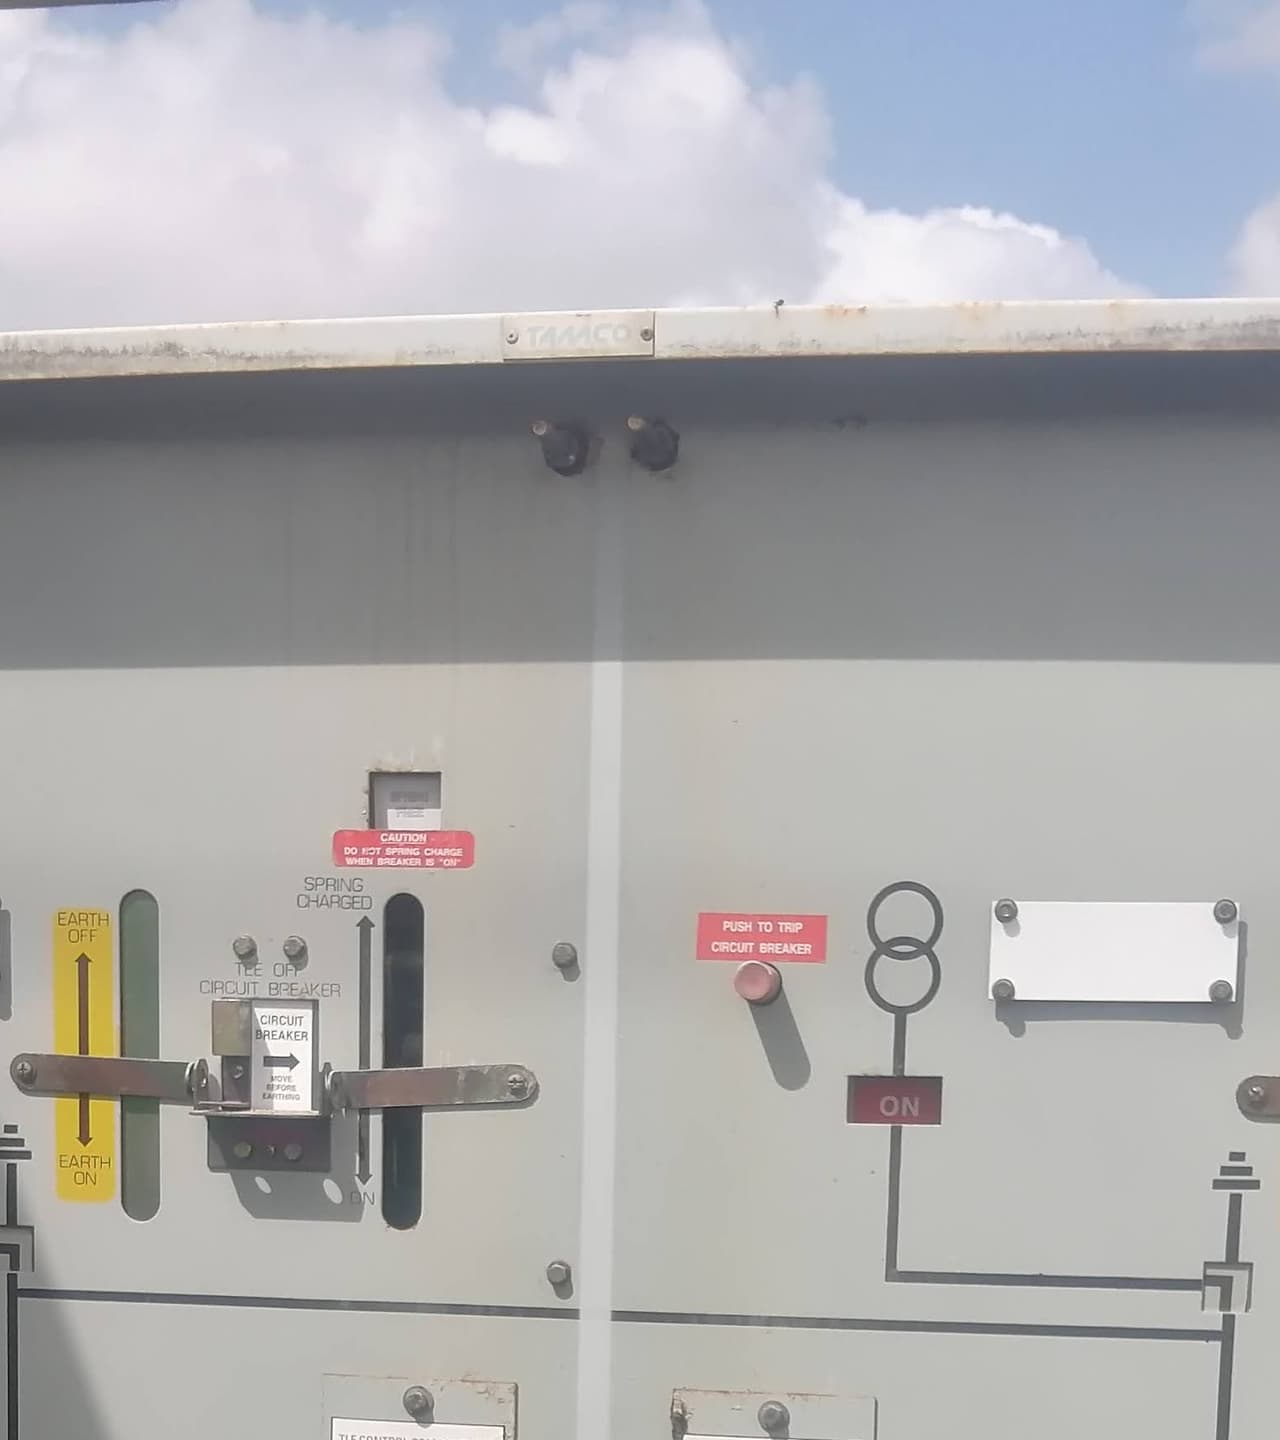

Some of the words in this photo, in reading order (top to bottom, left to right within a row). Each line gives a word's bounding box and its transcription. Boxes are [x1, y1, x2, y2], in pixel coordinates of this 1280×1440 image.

[527, 322, 632, 347] TAMCO
[380, 833, 427, 843] CAUTION
[344, 847, 358, 855] DO
[362, 847, 382, 855] NOT
[385, 848, 420, 856] SPRING
[424, 848, 463, 857] CHARGE
[345, 857, 374, 866] WHEN
[377, 858, 421, 866] BREAKER
[425, 858, 435, 867] IS
[439, 858, 461, 867] "ON"
[303, 877, 365, 894] SPRING
[296, 894, 373, 911] CHARGED
[57, 911, 111, 928] EARTH
[722, 920, 753, 933] PUSH
[758, 921, 774, 933] TO
[778, 921, 804, 934] TRIP
[67, 928, 98, 944] OFF
[711, 942, 755, 954] CIRCUIT
[759, 942, 812, 955] BREAKER
[235, 962, 264, 977] TEE
[273, 962, 302, 978] OFF
[199, 980, 259, 996] CIRCUIT
[267, 982, 342, 998] BREAKER
[260, 1015, 305, 1027] CIRCUIT
[255, 1029, 309, 1041] BREAKER
[270, 1075, 294, 1084] MOVE
[266, 1084, 297, 1093] BEFORE
[261, 1093, 301, 1101] EARTHING
[878, 1095, 920, 1117] ON
[58, 1154, 111, 1170] EARTH
[73, 1170, 98, 1186] ON
[350, 1191, 376, 1206] ON
